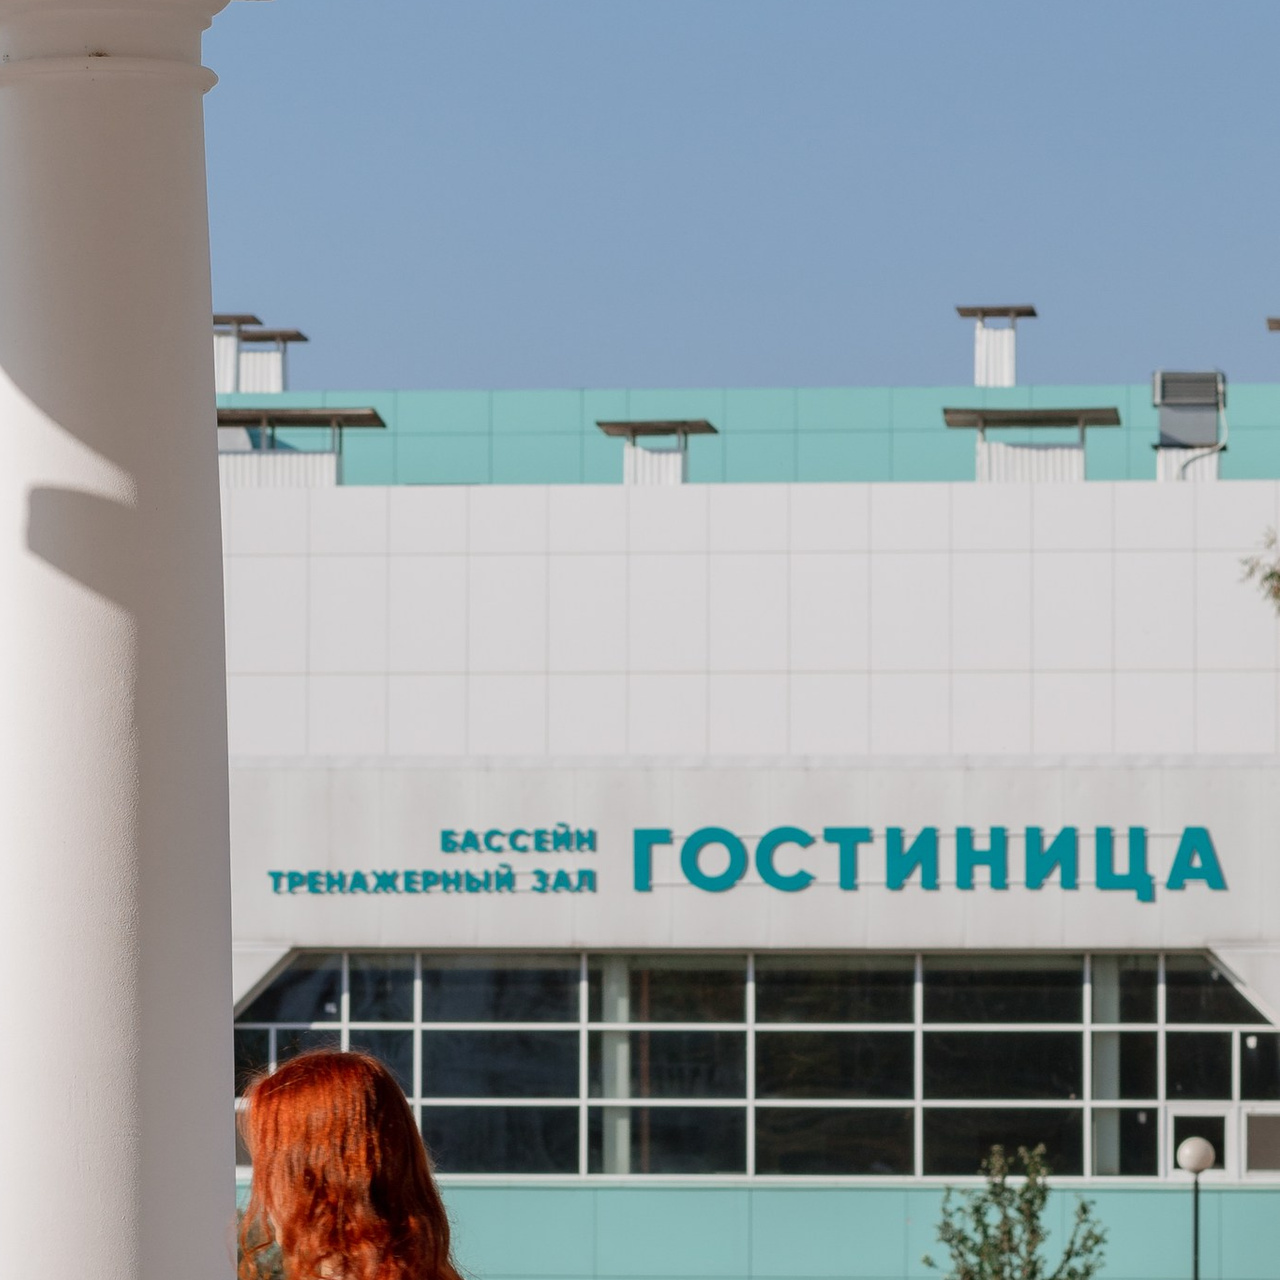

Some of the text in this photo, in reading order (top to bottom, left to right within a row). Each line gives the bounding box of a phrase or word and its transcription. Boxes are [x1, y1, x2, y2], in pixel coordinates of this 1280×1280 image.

[440, 822, 596, 853] БАССЕЙН
[269, 863, 596, 894] ТРЕНАЖЕРНЫЙ ЗАЛ
[633, 825, 1227, 902] ГОСТИНИЦА
